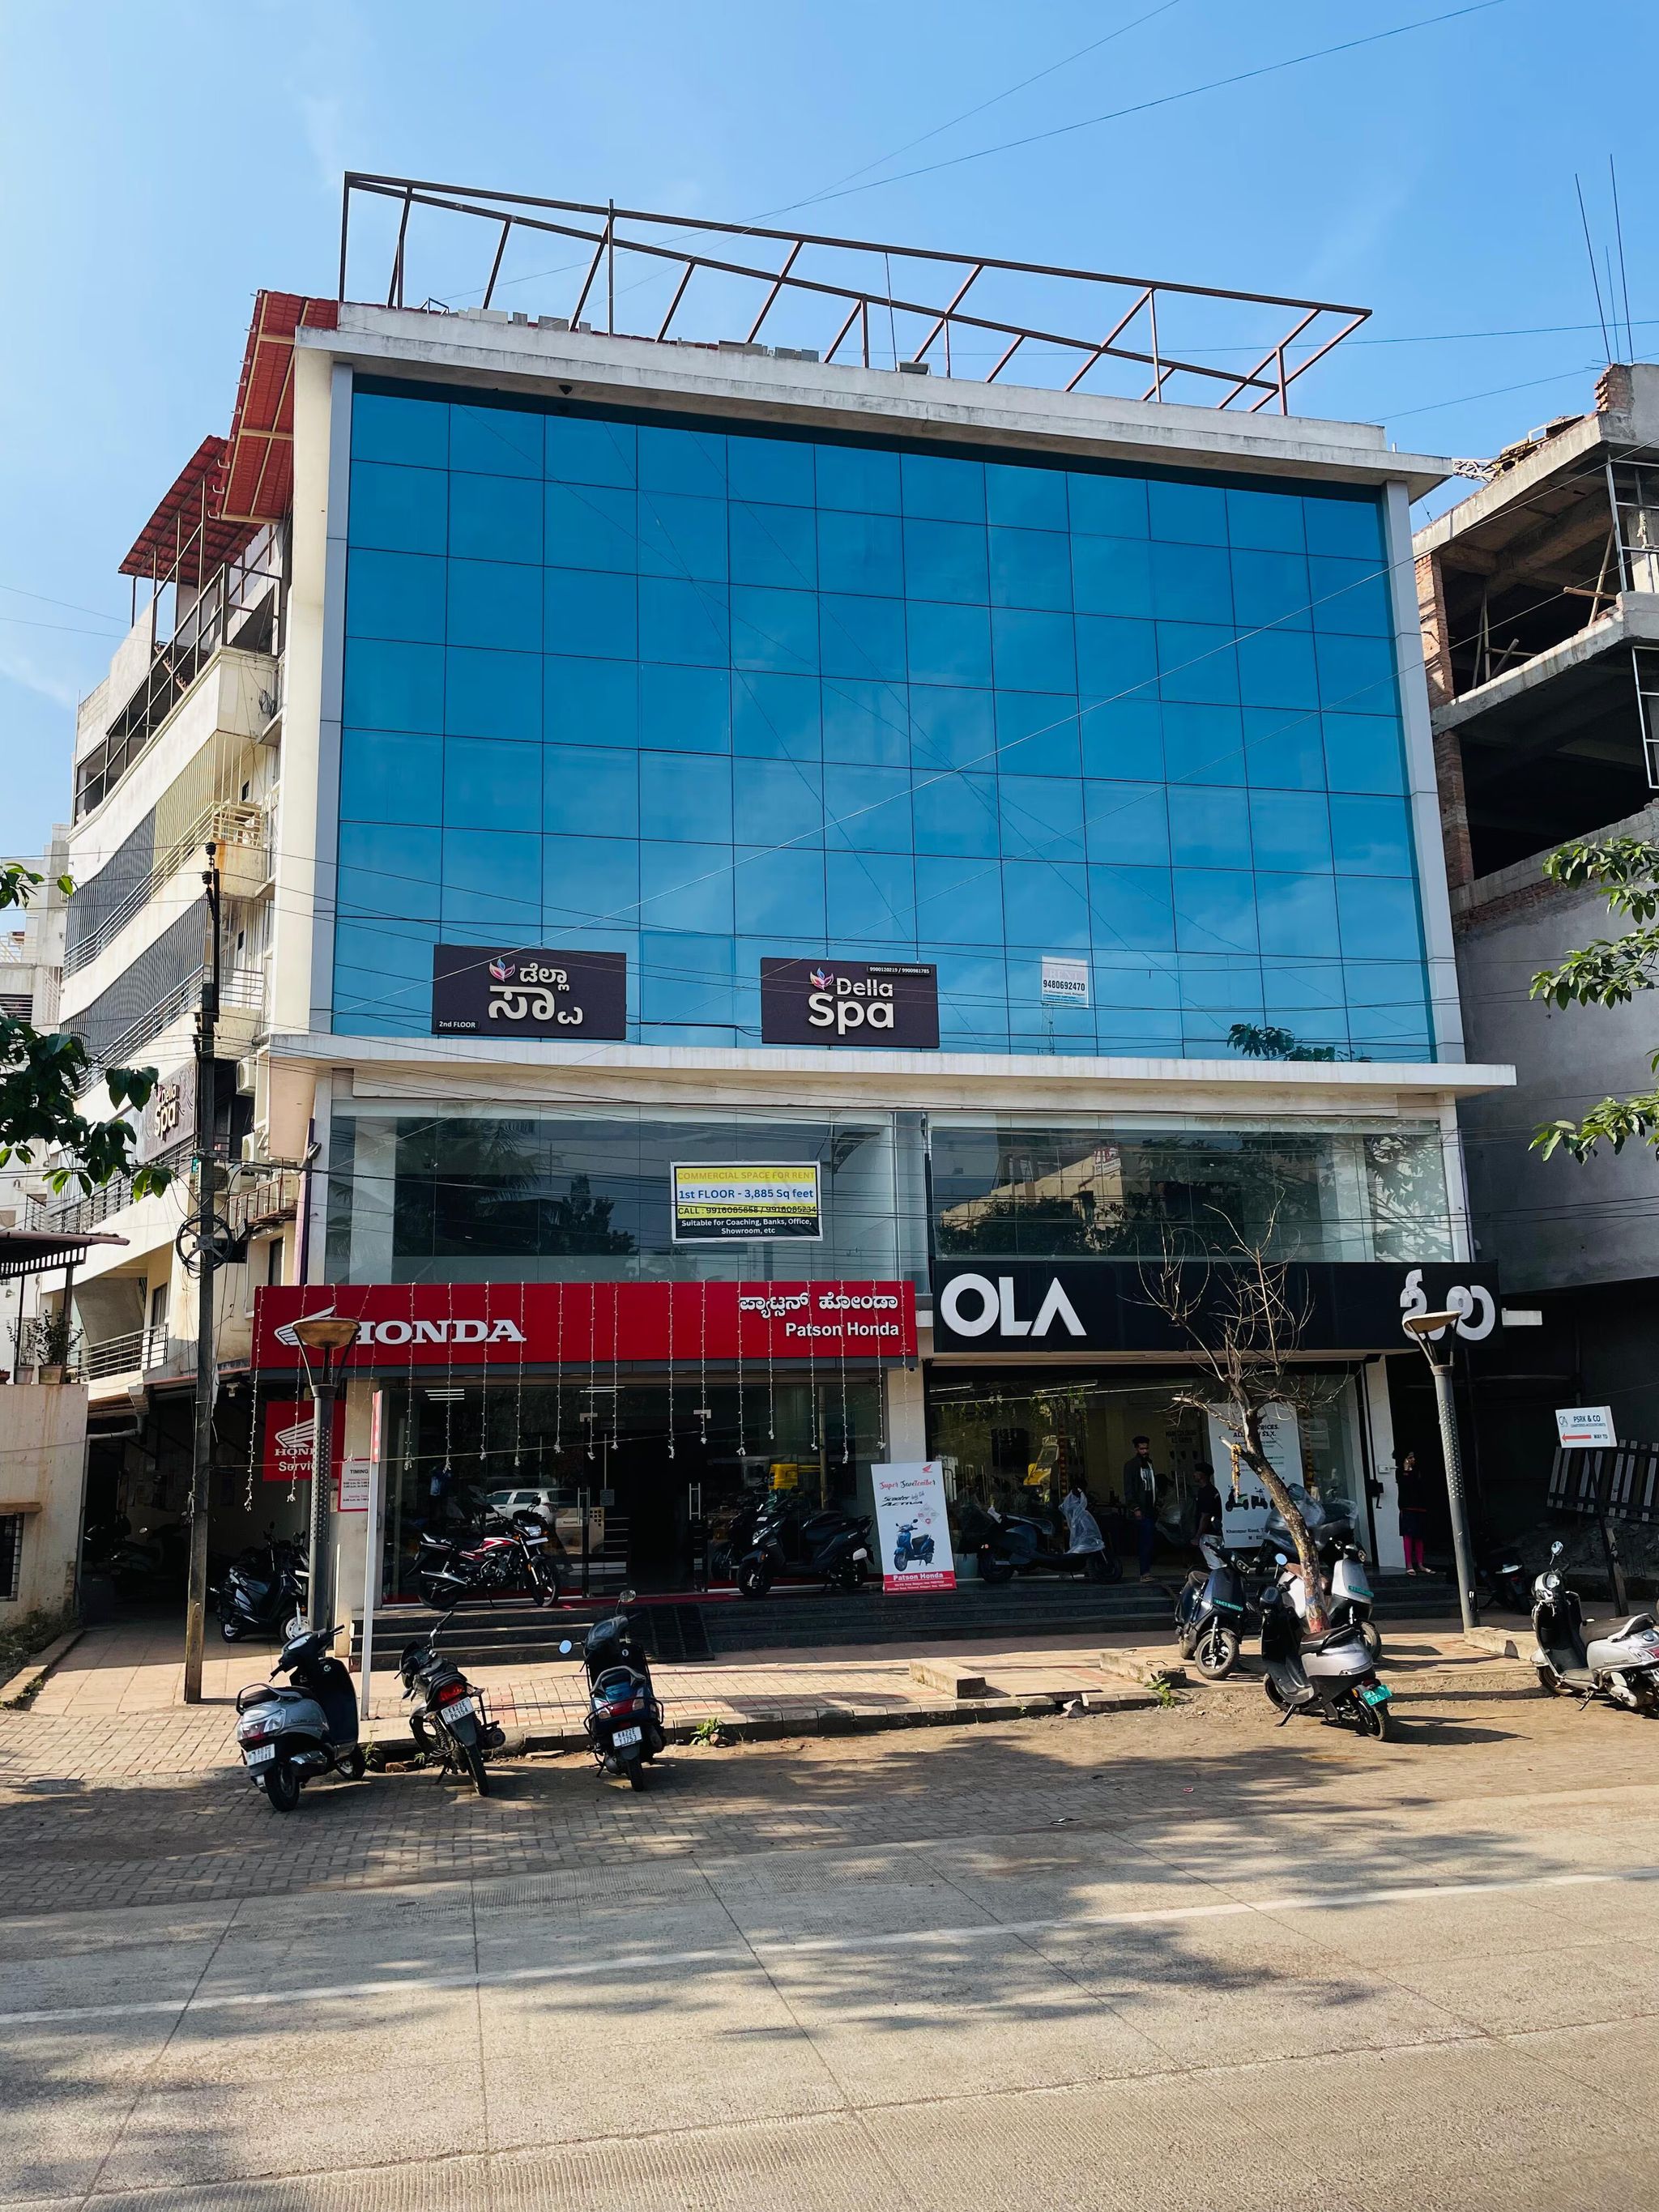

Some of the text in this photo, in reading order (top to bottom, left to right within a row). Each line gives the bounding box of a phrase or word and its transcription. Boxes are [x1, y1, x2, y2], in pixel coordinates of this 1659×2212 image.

[836, 978, 893, 997] Della
[1043, 979, 1085, 991] 9480692470
[808, 992, 894, 1035] Spa
[155, 1101, 177, 1141] Spa
[677, 1171, 815, 1180] COMMERCIAL SPACE FOR RENT
[679, 1190, 695, 1200] 1st
[697, 1189, 735, 1199] FLOOR
[744, 1189, 774, 1200] 3,885
[776, 1189, 790, 1200] Sq
[792, 1188, 814, 1198] feet
[678, 1207, 700, 1215] CALL
[681, 1219, 712, 1227] Suitable
[726, 1218, 761, 1227] Coaching,
[763, 1218, 787, 1226] Banks,
[818, 1291, 898, 1310] ಹೋಂಡಾ
[940, 1272, 1088, 1337] OLA
[786, 1322, 899, 1336] Patson Honda
[275, 1448, 314, 1456] HON
[879, 1481, 898, 1490] Super
